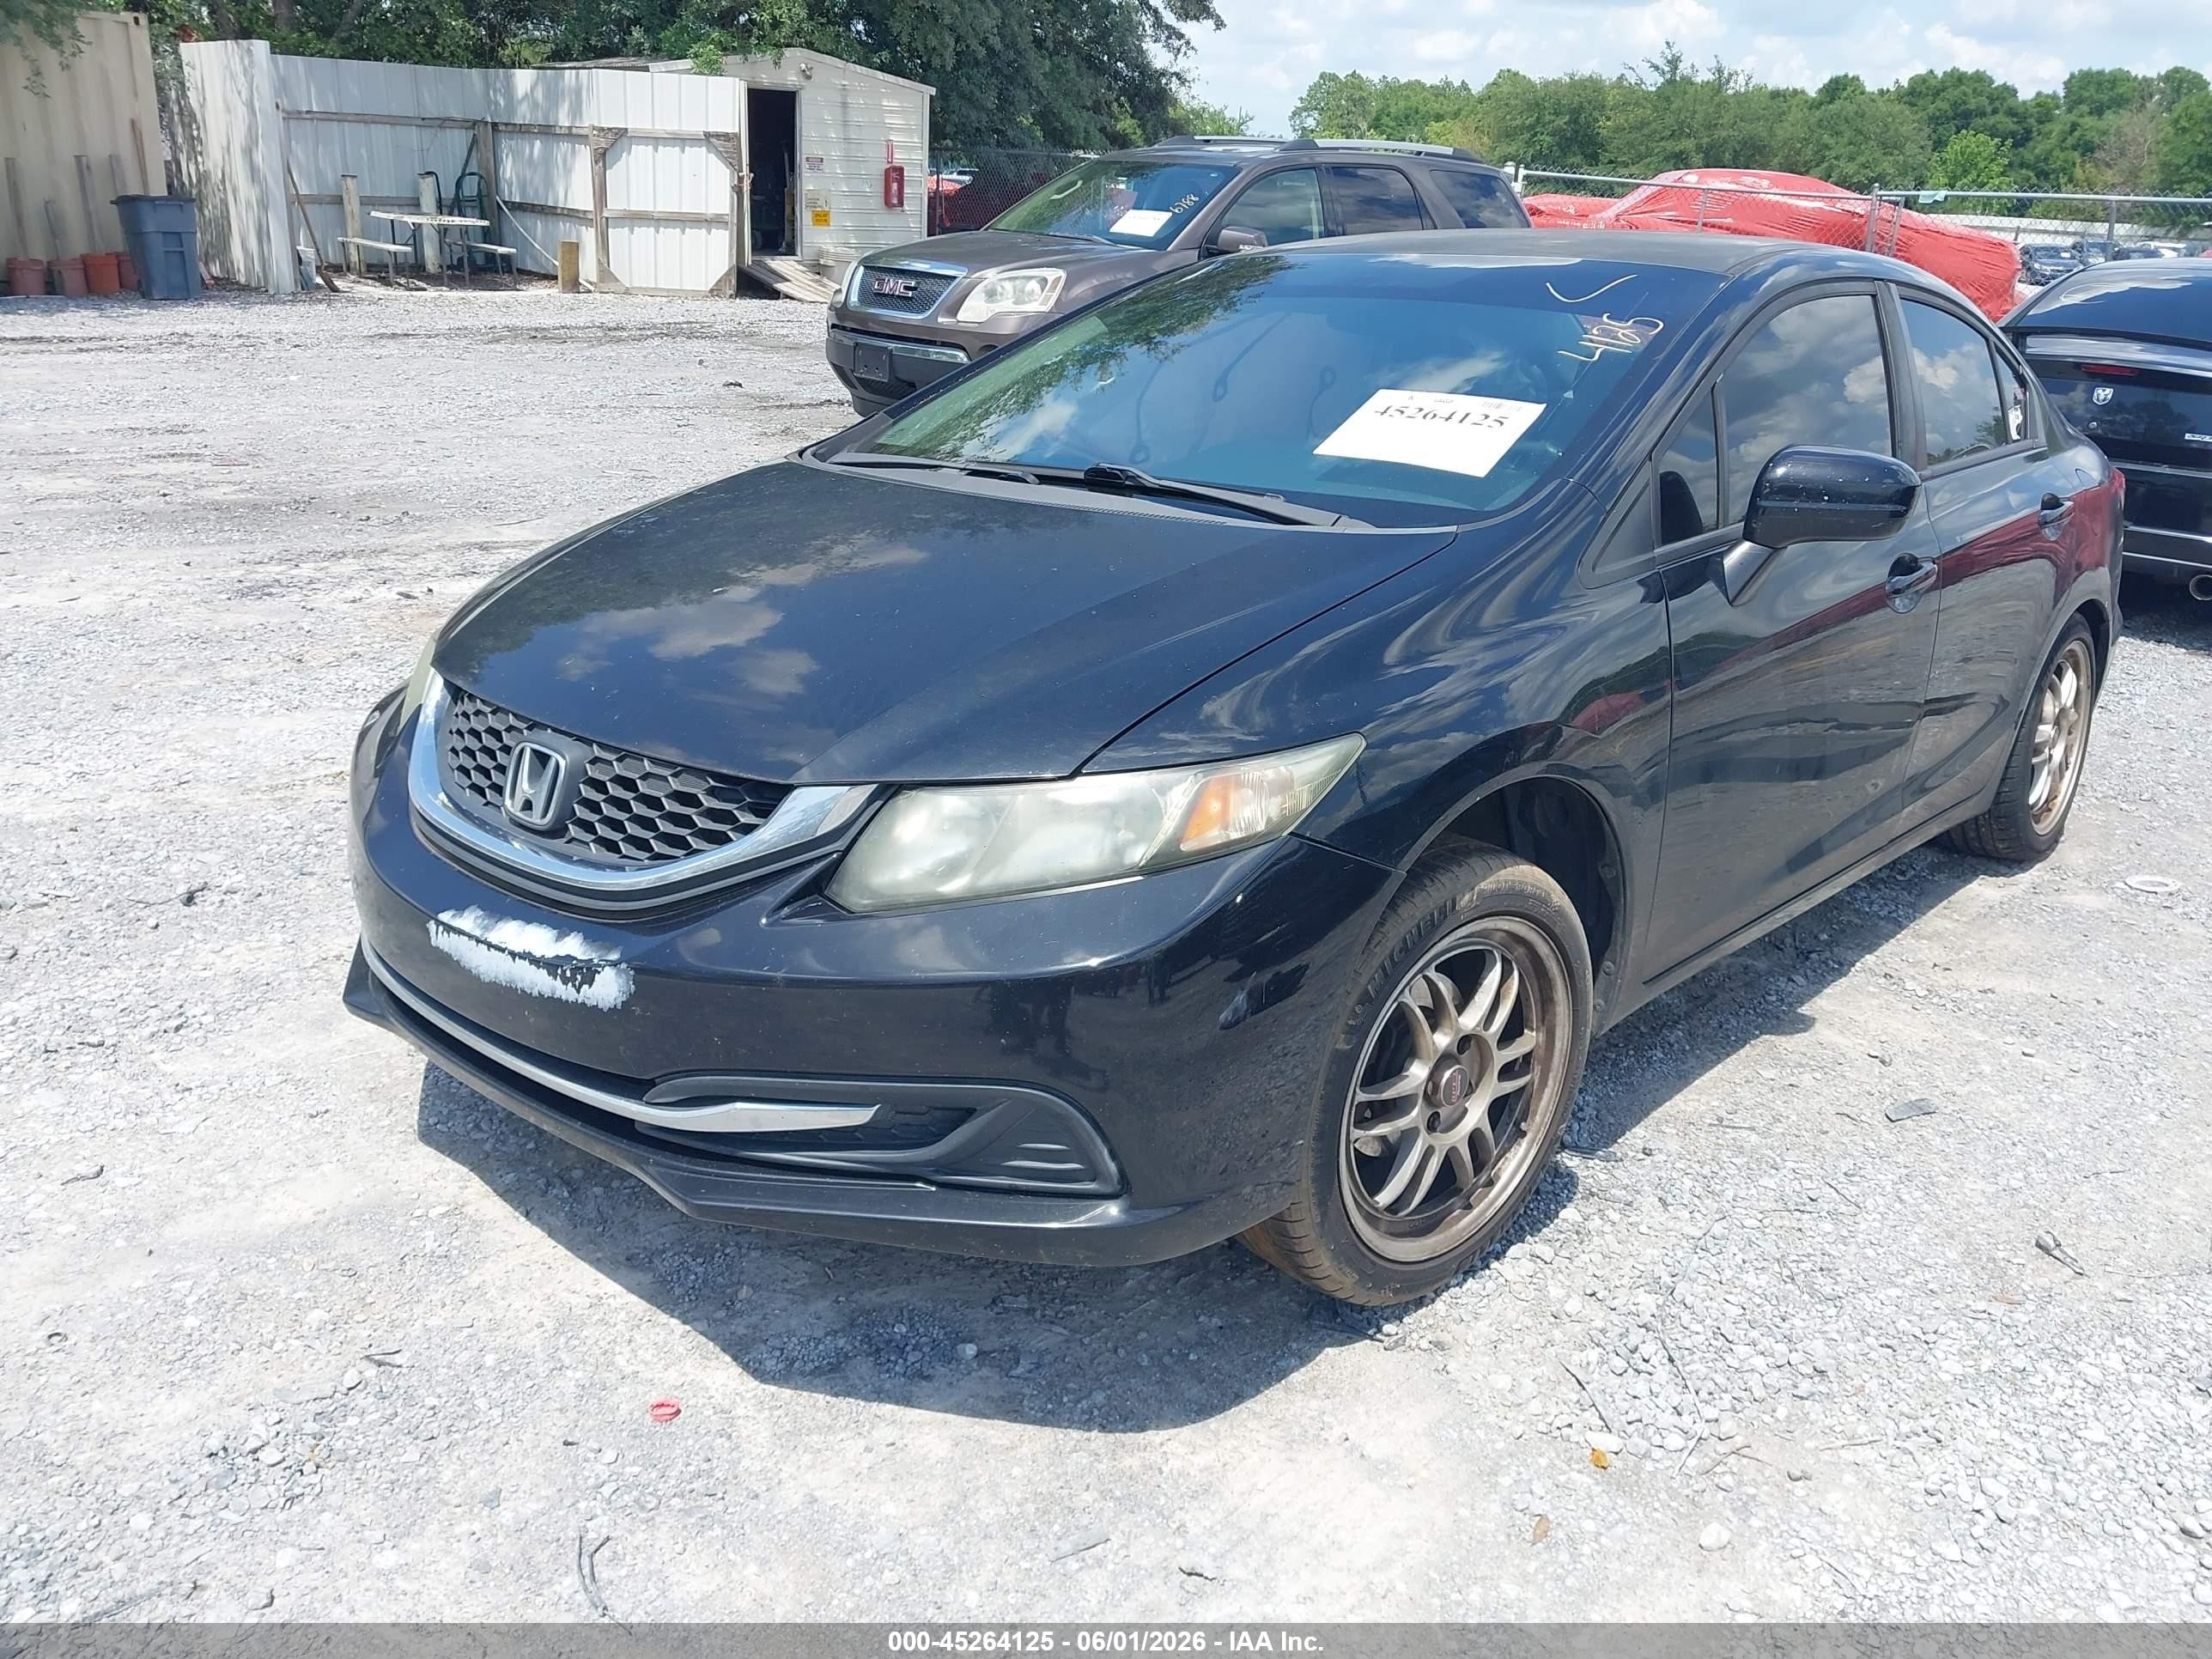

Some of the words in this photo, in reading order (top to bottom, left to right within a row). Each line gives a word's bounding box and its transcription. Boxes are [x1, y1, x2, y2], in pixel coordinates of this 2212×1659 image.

[1169, 193, 1200, 214] 6788
[872, 277, 915, 297] GMC
[1557, 313, 1664, 362] 4125
[1374, 404, 1510, 428] 45264125
[1368, 895, 1463, 999] MICHELI
